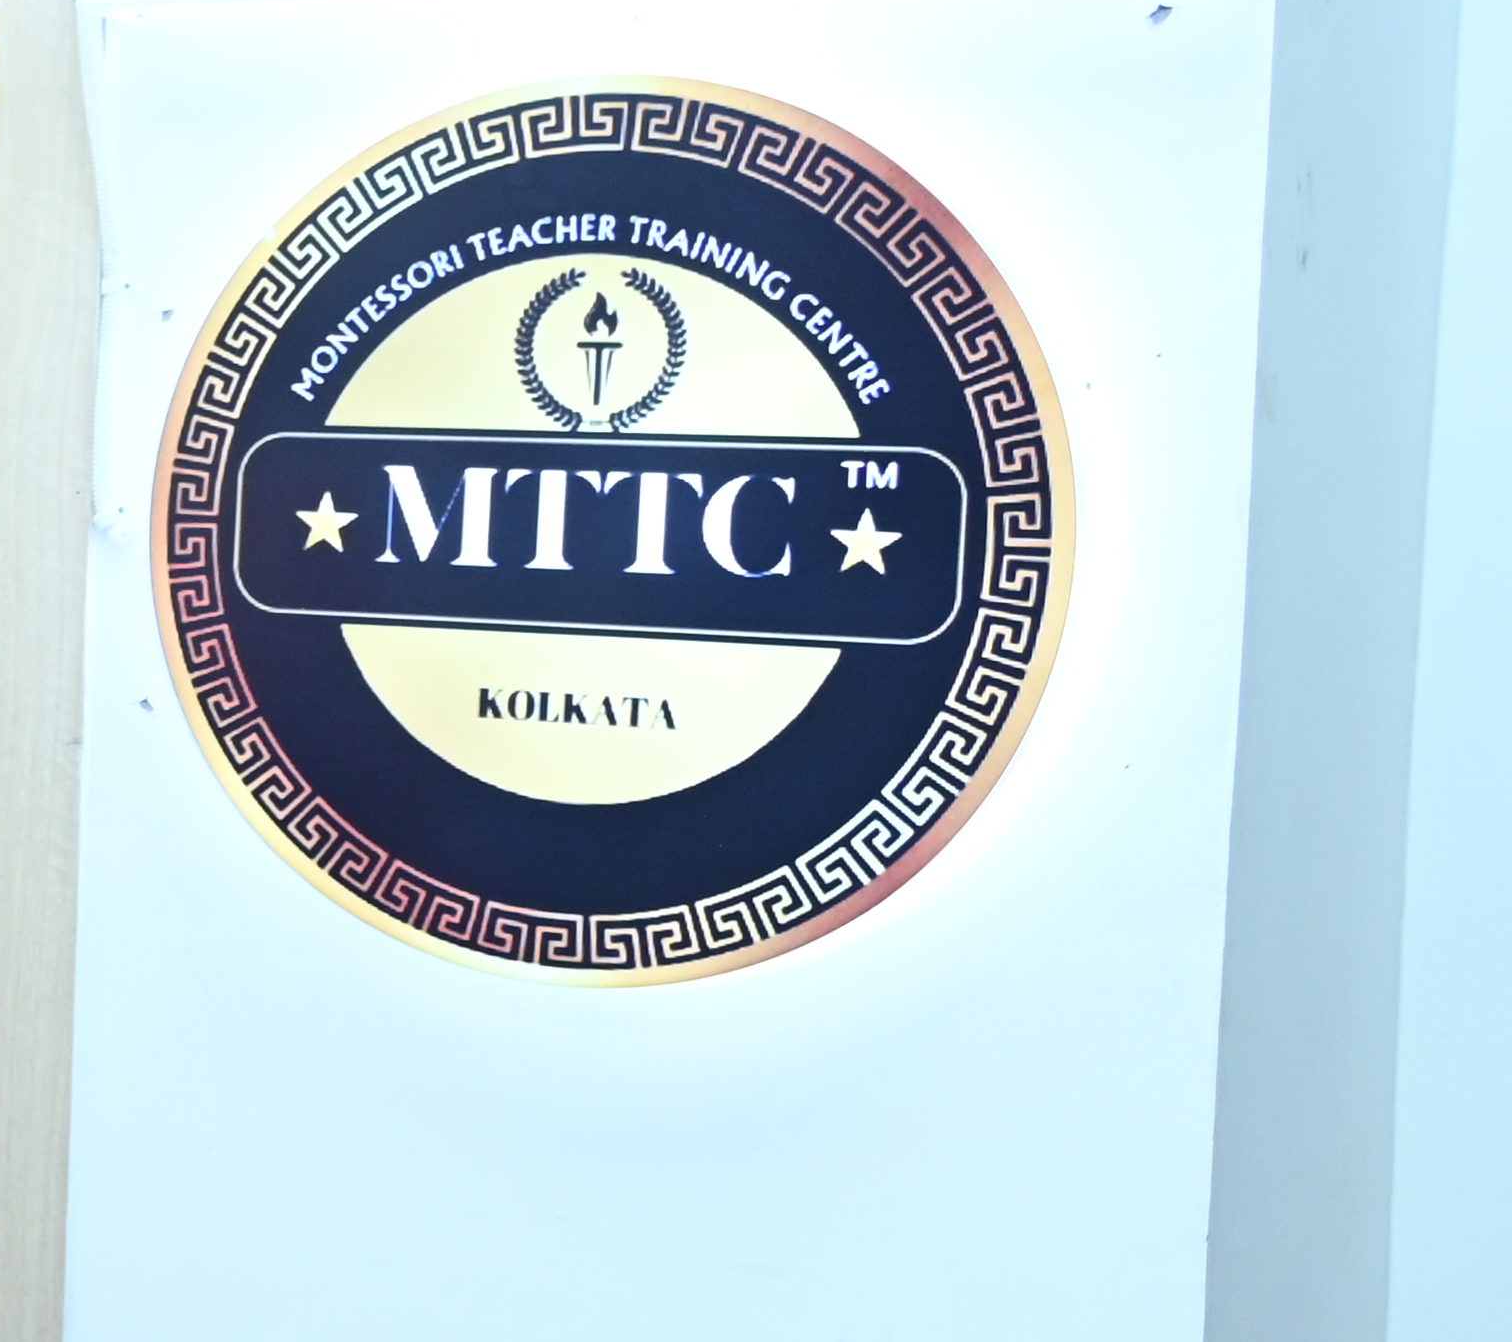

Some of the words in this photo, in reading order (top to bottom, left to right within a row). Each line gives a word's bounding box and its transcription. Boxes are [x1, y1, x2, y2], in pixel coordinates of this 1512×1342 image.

[290, 241, 463, 403] MONTESSORI
[467, 214, 616, 264] TEACHER
[628, 215, 792, 303] TRAINING
[788, 292, 893, 405] CENTRE
[374, 463, 796, 578] MTTC
[841, 461, 898, 490] TM
[476, 687, 676, 732] KOLKATA
